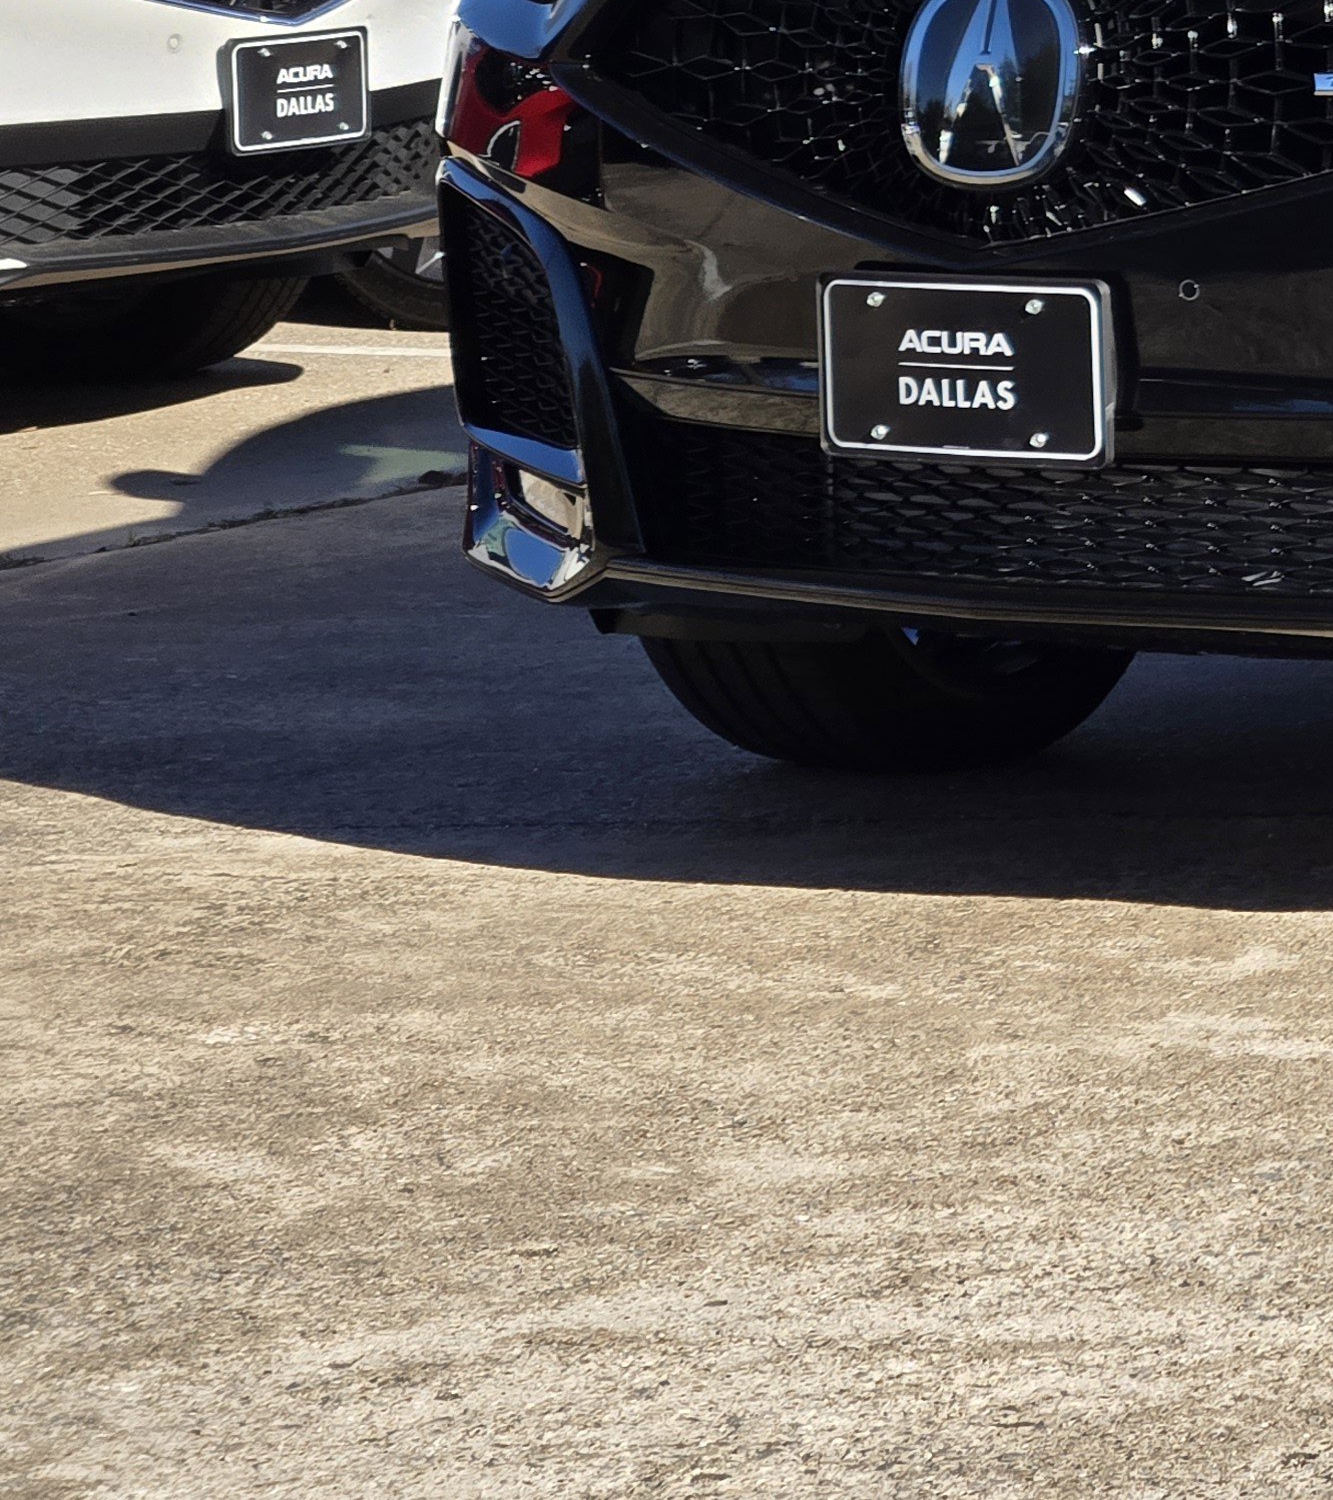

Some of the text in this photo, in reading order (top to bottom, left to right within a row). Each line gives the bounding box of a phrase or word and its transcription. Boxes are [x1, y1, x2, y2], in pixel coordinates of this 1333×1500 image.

[276, 63, 335, 85] ACURA
[276, 92, 335, 118] DALLAS
[897, 329, 1015, 357] ACURA
[898, 376, 1016, 411] DALLAS
